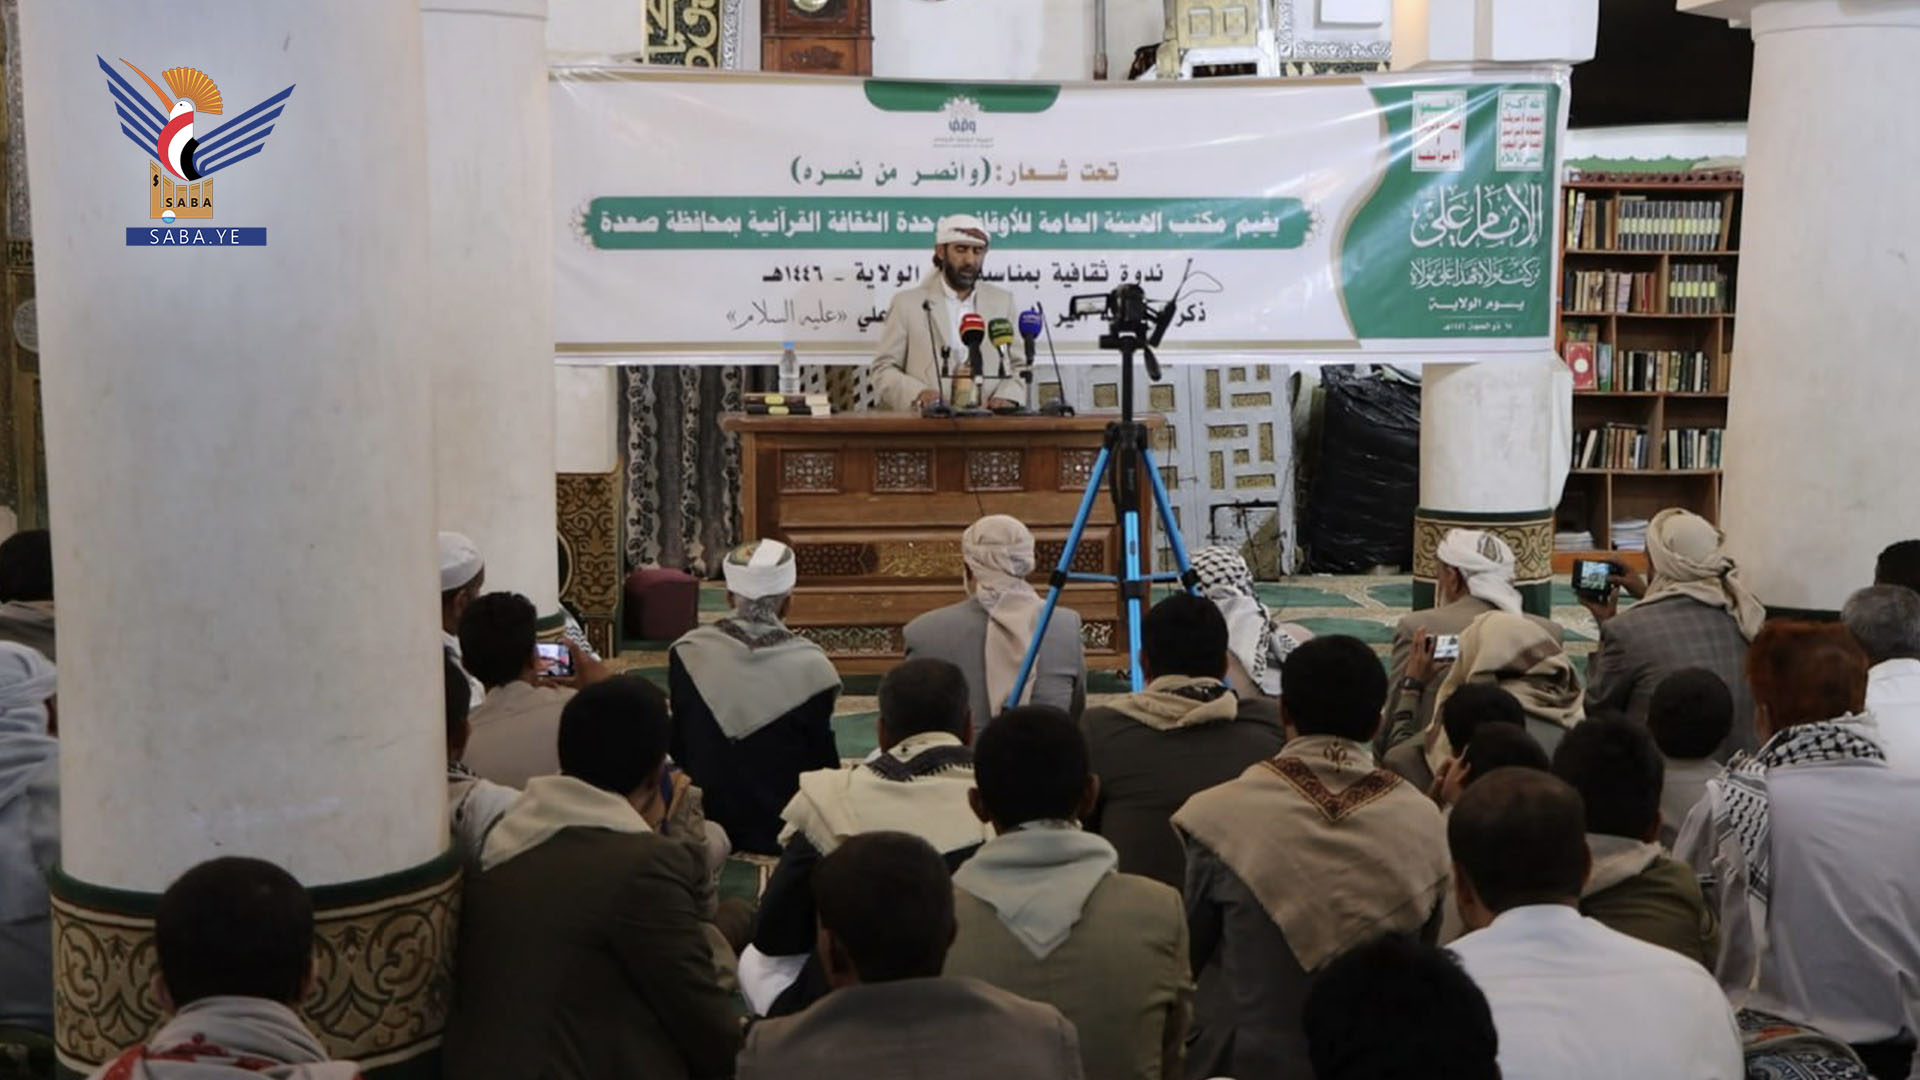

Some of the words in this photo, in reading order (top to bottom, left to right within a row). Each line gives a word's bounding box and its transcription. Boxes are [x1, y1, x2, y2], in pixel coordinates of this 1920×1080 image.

[875, 162, 897, 187] من
[1081, 161, 1119, 181] تحت
[600, 211, 660, 233] صعدة
[666, 210, 742, 238] بمحافظة
[748, 206, 821, 238] القرآنية
[828, 209, 889, 233] الثقافة
[1039, 210, 1098, 233] العامة
[1104, 211, 1163, 238] الهيئة
[1169, 210, 1227, 238] مكتب
[1236, 211, 1280, 240] يقيم
[856, 262, 920, 288] الولاية
[1052, 260, 1110, 288] ثقافية
[1121, 263, 1163, 286] ندوة
[857, 307, 889, 332] علي
